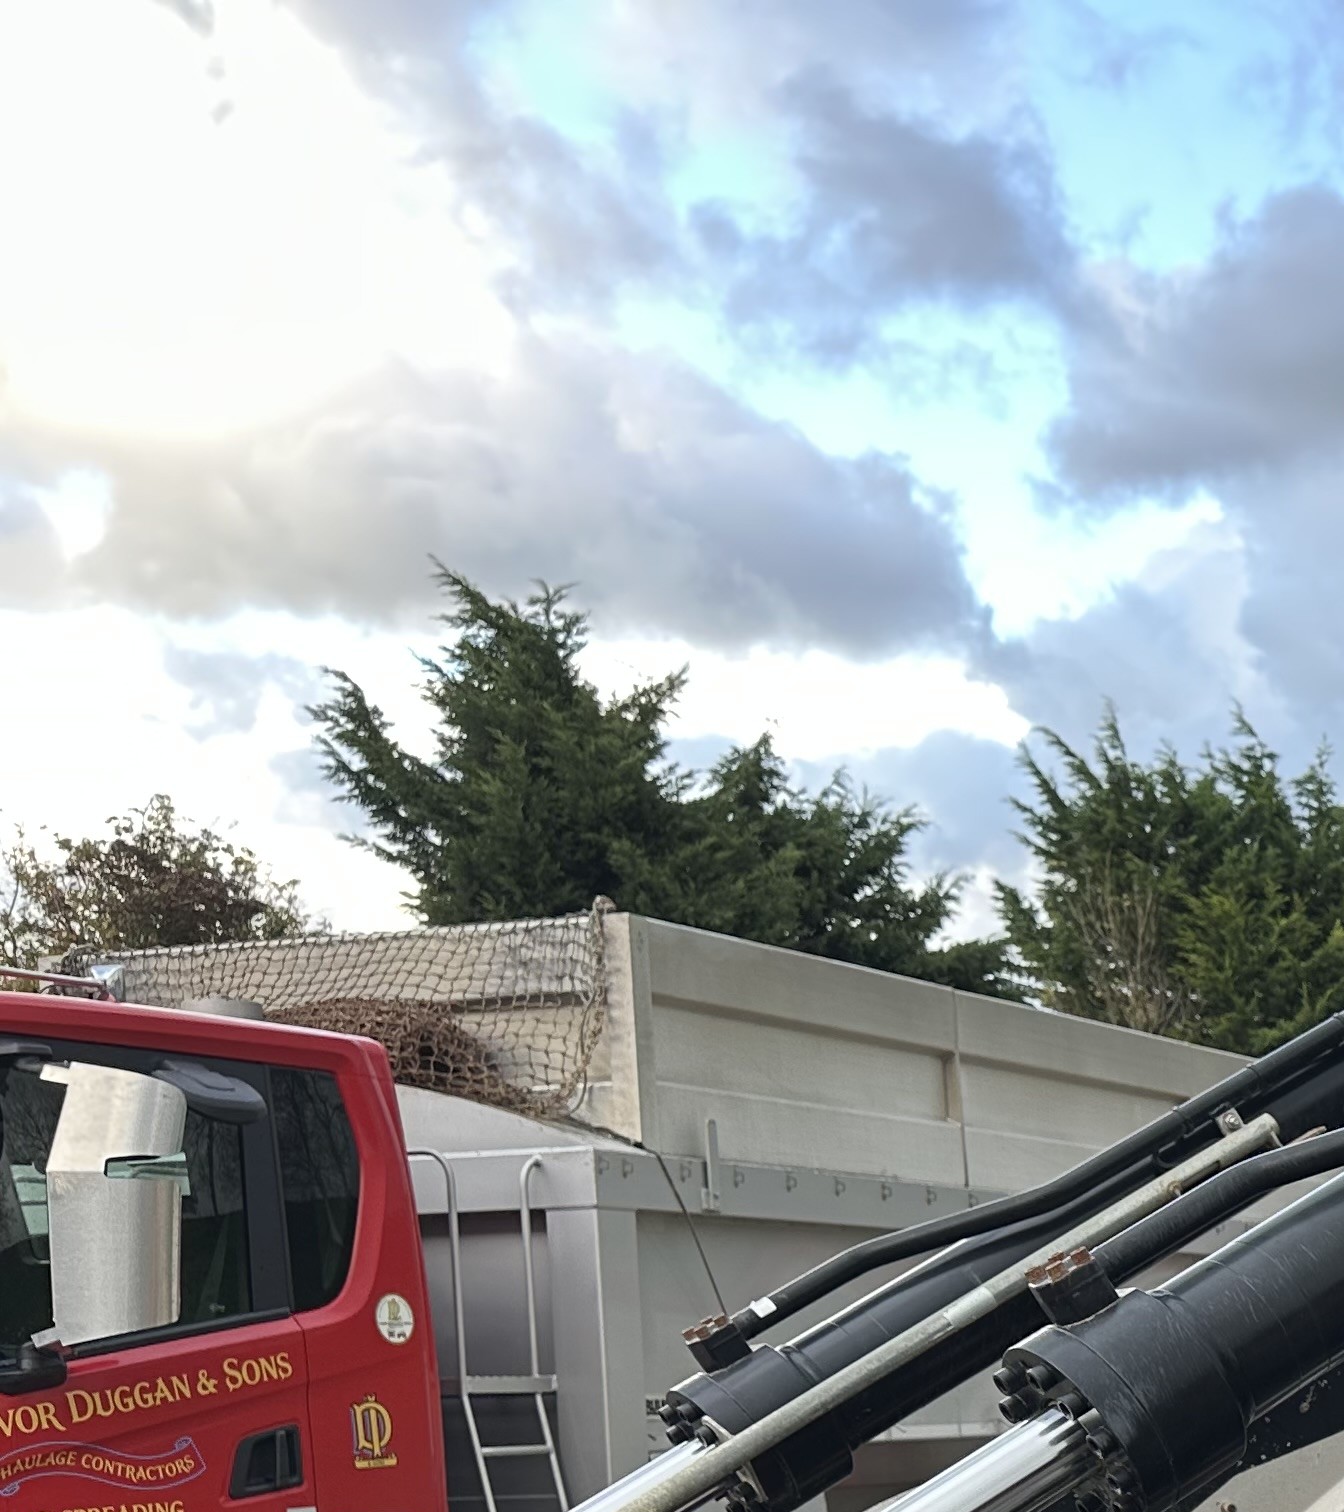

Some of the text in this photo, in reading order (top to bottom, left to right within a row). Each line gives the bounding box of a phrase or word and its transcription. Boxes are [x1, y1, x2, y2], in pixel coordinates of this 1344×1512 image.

[196, 1369, 219, 1396] &
[1, 1450, 196, 1484] HAULAGE CONTRACTORS
